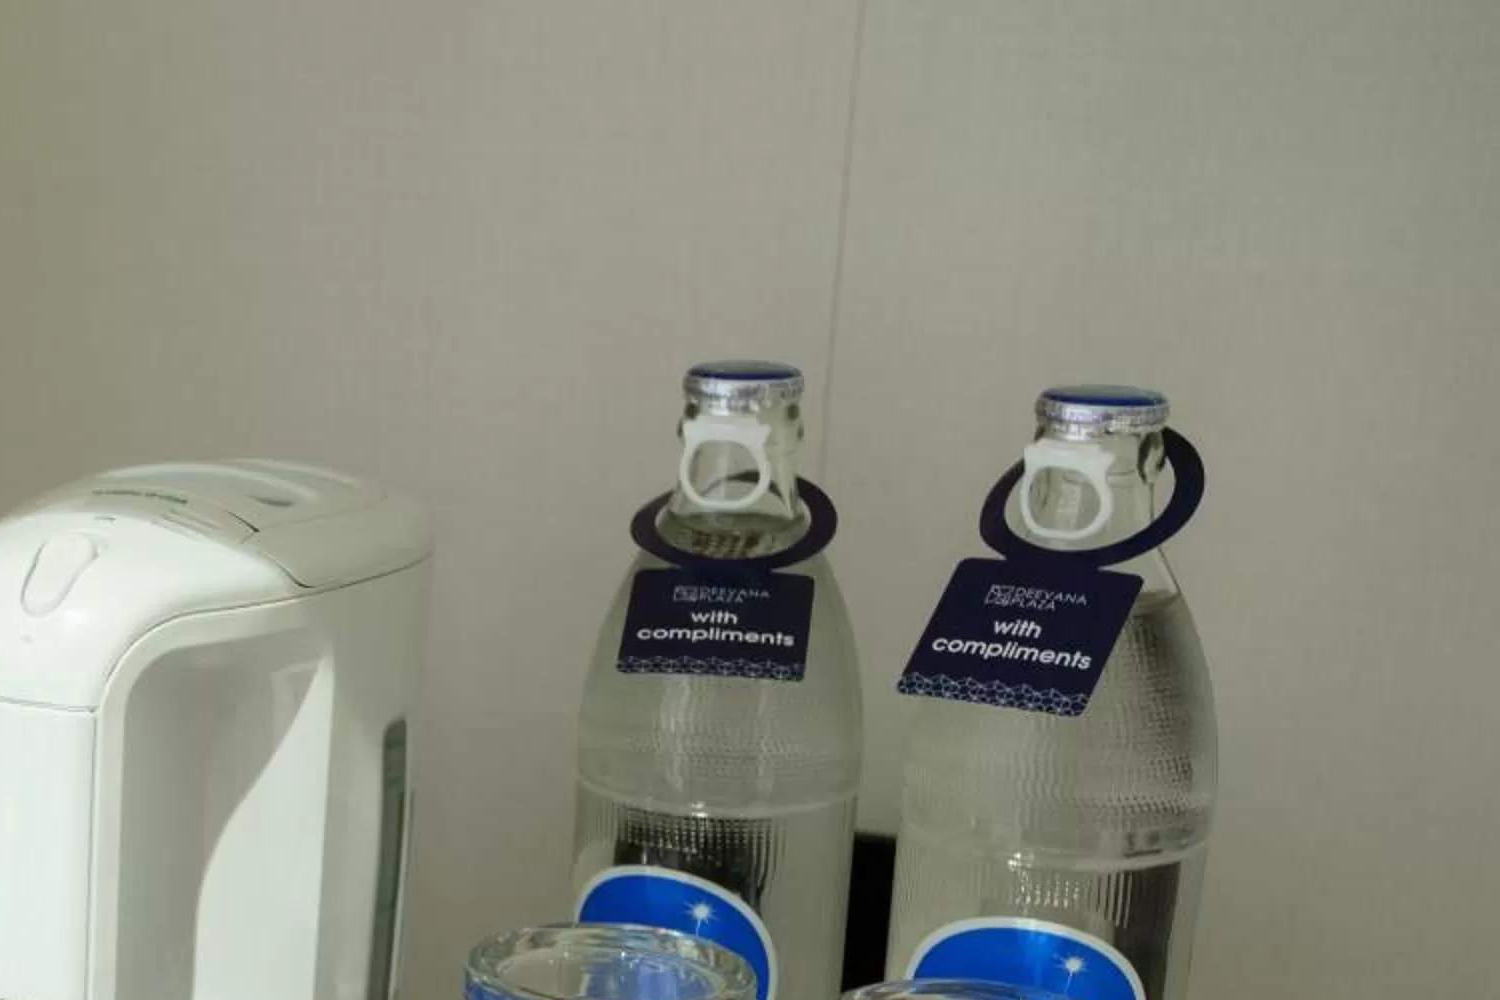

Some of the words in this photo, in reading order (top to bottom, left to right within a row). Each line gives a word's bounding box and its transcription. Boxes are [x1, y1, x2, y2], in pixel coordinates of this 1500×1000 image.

[699, 586, 771, 599] DEEVANA
[1015, 586, 1088, 606] DEEVANA
[1011, 597, 1057, 612] PLAZA
[690, 609, 739, 625] with
[636, 627, 796, 648] compliments
[992, 619, 1043, 639] with
[931, 637, 1093, 671] compliments
